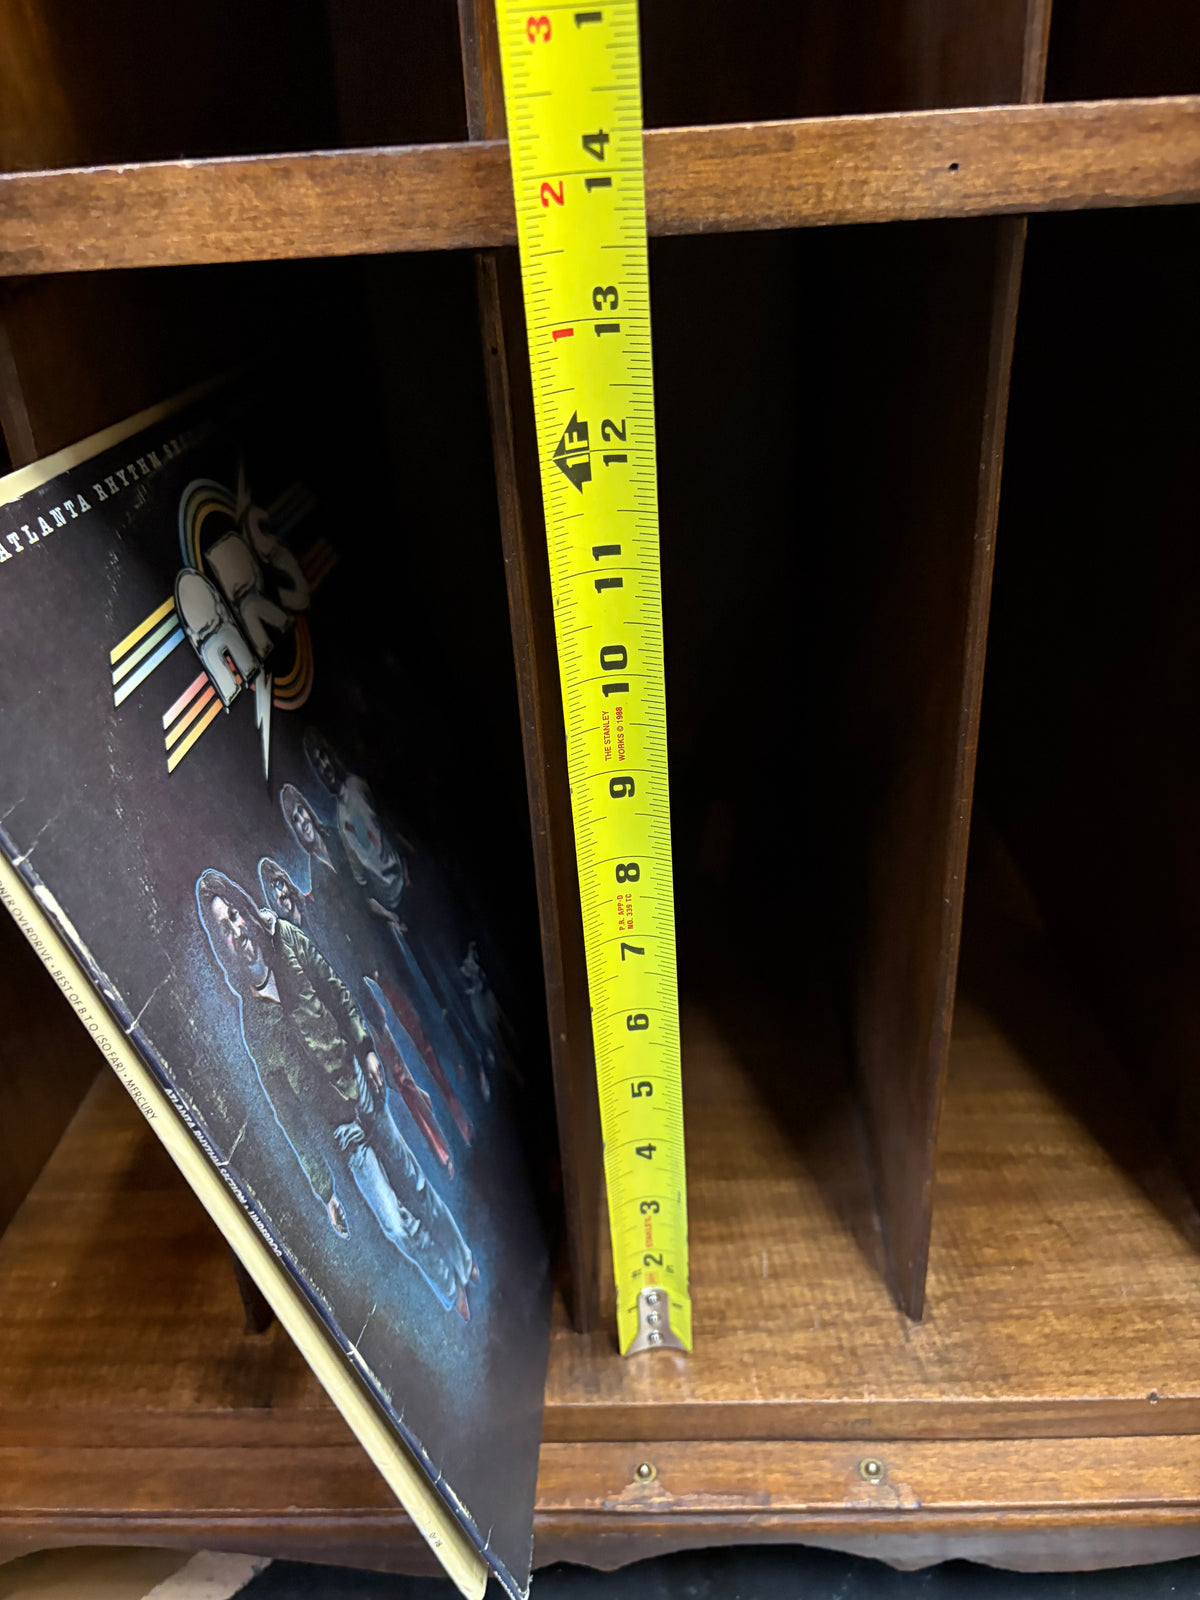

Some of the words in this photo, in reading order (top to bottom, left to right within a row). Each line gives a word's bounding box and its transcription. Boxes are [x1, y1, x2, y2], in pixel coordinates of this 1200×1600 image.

[527, 15, 552, 43] 3
[540, 180, 565, 208] 2
[592, 285, 620, 337] 13
[552, 327, 574, 342] 1
[600, 418, 628, 467] 12
[0, 494, 91, 563] ATLANTA
[93, 451, 162, 502] RHYTHM
[592, 544, 623, 593] 11
[599, 644, 629, 698] 10
[615, 706, 623, 724] 1988
[602, 710, 611, 746] STANLEY
[604, 747, 612, 762] THE
[617, 733, 625, 762] WORKS
[609, 776, 636, 799] 9
[615, 862, 641, 884] 8
[625, 901, 633, 915] 339
[626, 917, 634, 930] NO.
[621, 942, 647, 961] 7
[12, 906, 53, 963] OVERDRIVE
[53, 970, 69, 993] BEST
[68, 991, 83, 1009] OF
[95, 1034, 111, 1053] (SO
[108, 1050, 125, 1075] FAR)
[126, 1079, 158, 1121] MERCURY
[627, 1012, 649, 1032] 6
[631, 1080, 654, 1098] 5
[636, 1143, 657, 1160] 4
[164, 1088, 195, 1128] ATLANTA
[193, 1128, 221, 1167] RHYTHM
[220, 1168, 247, 1204] SECTION
[248, 1211, 282, 1257] UNDERDOG
[640, 1200, 660, 1214] 3
[643, 1253, 663, 1266] 2
